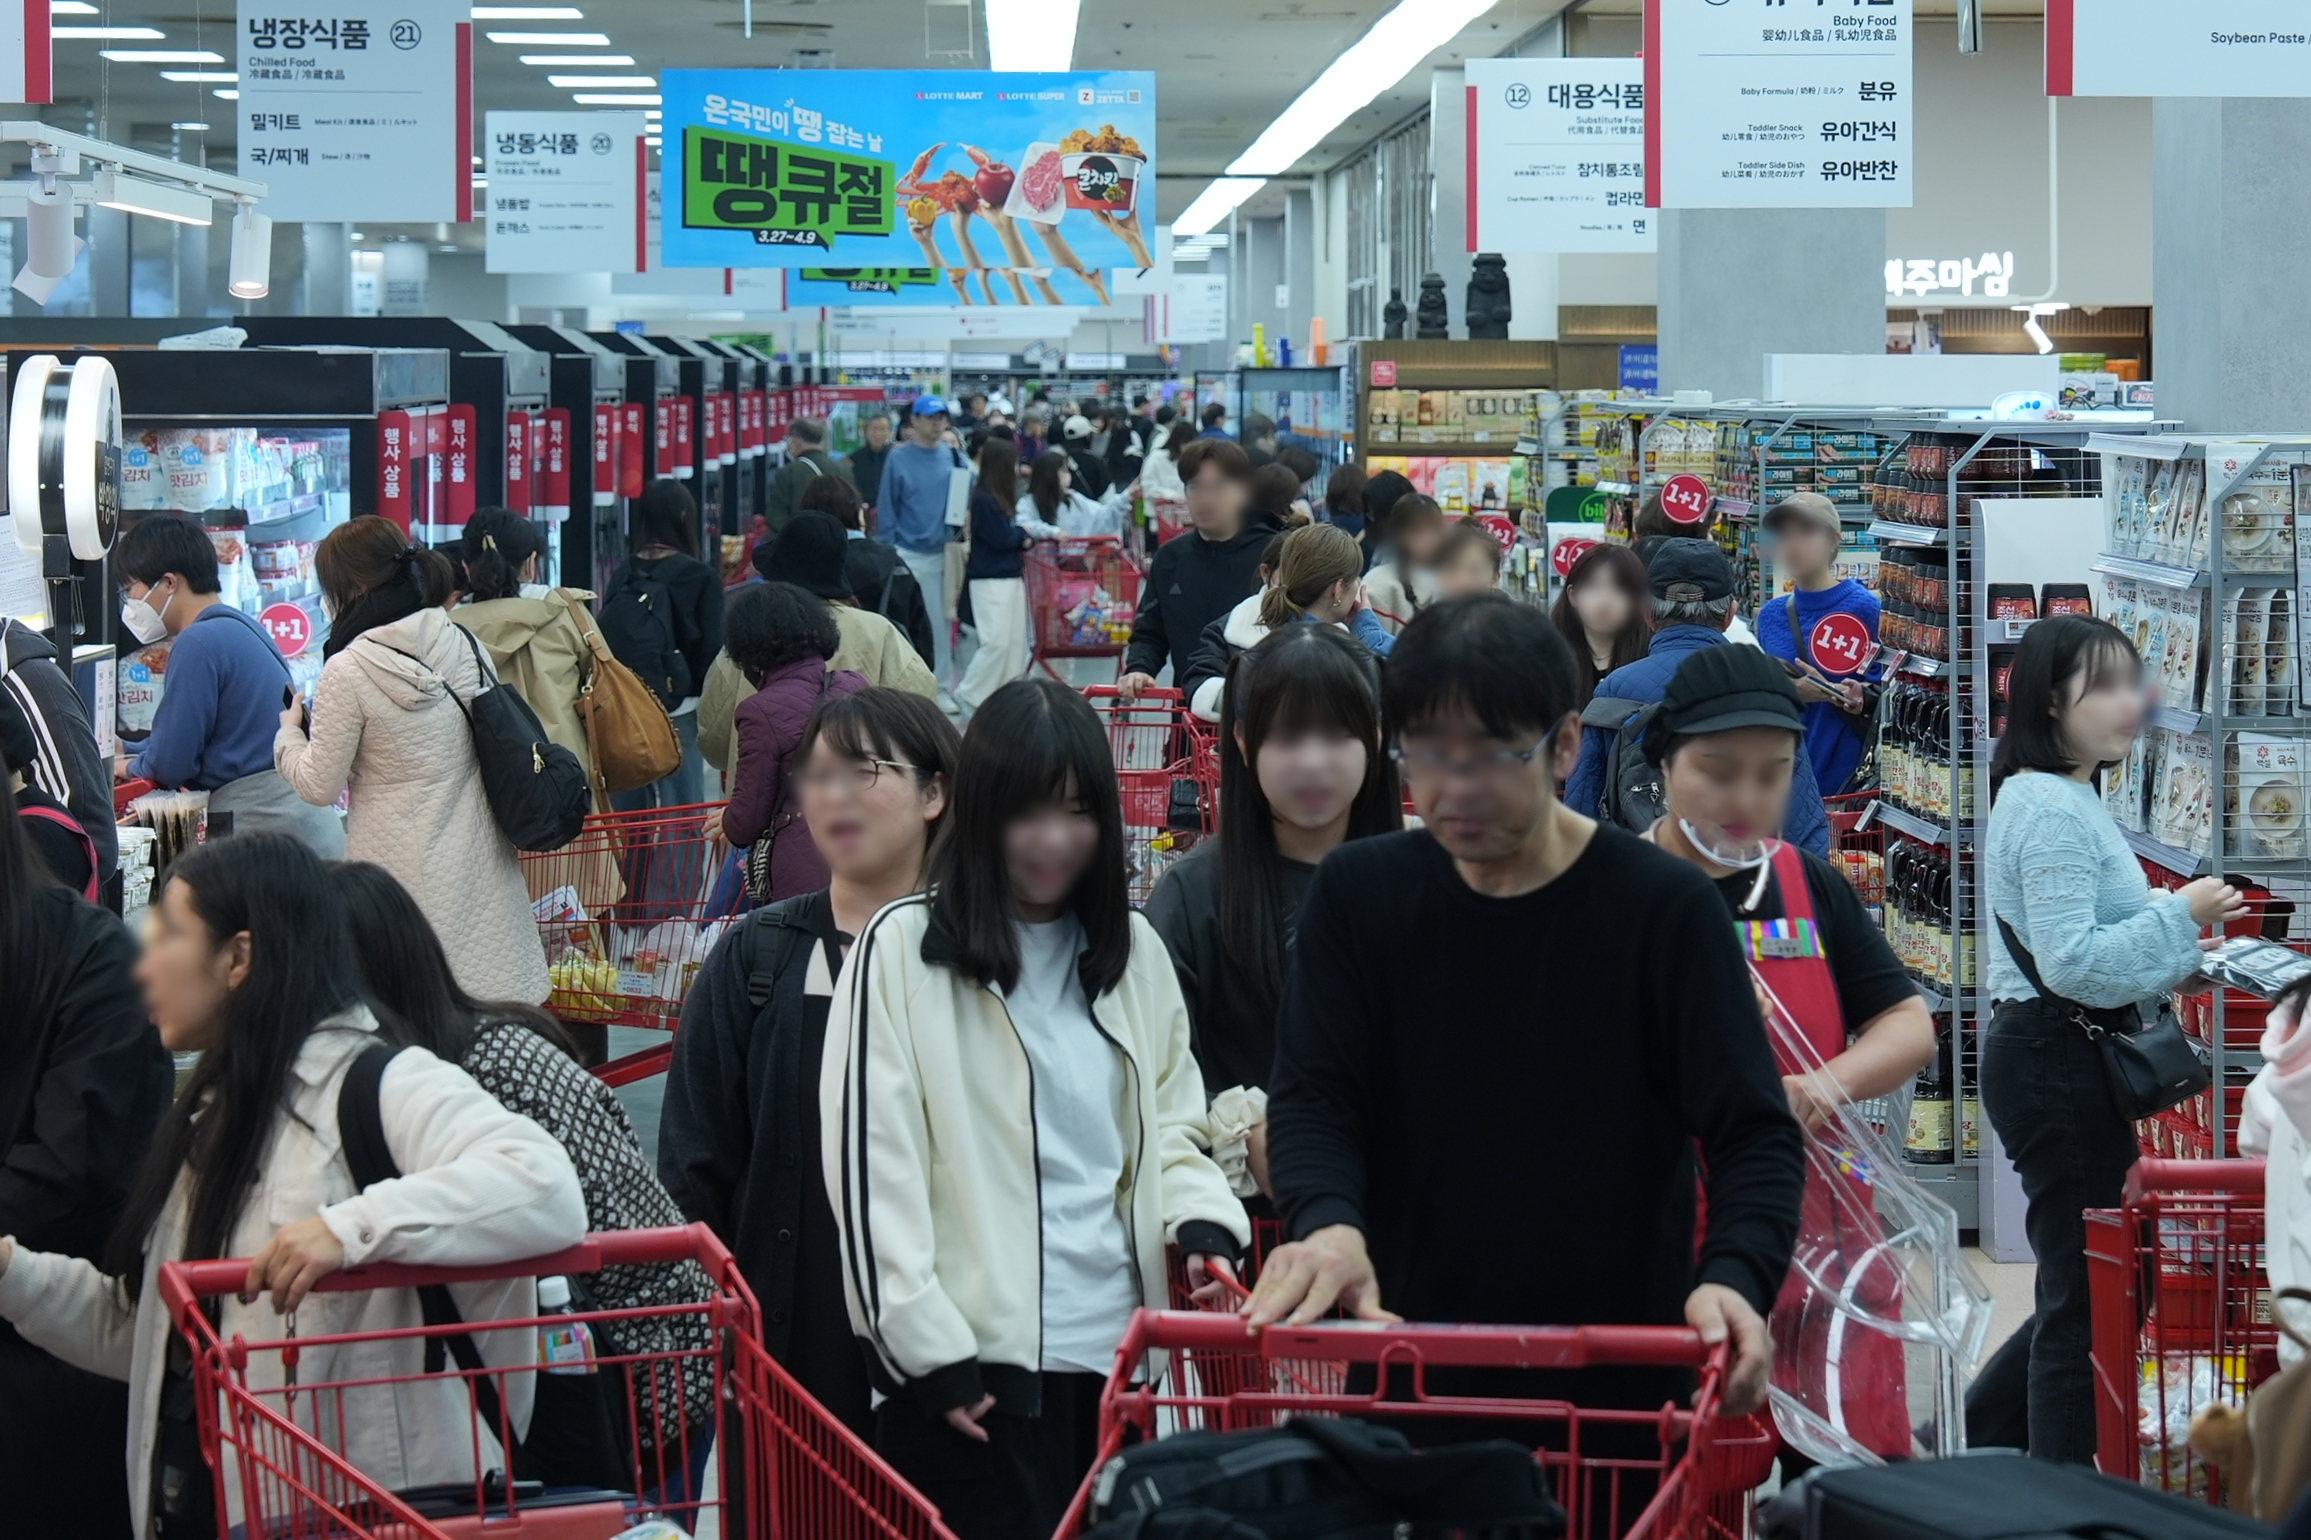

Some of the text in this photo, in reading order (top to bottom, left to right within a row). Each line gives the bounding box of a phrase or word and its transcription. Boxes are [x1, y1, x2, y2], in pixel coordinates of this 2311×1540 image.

[1833, 15, 1897, 27] Baby Food
[249, 18, 370, 50] 냉장식품
[2210, 32, 2305, 45] Soybean Paste
[249, 57, 315, 67] Chilled Food
[925, 92, 983, 100] LOTTE MART
[1037, 92, 1064, 100] SUPER
[1097, 95, 1125, 103] ZETTA
[1548, 83, 1643, 109] 대용식품
[1741, 87, 1760, 96] Baby
[1858, 81, 1897, 101] 분유
[251, 113, 301, 131] 밀키트
[703, 94, 884, 153] 온국민이 땡 잡는 날
[1576, 116, 1622, 124] Substitute
[1748, 124, 1803, 132] Toddler Snack
[1820, 121, 1896, 142] 유아간식
[496, 133, 578, 154] 냉동식품
[250, 148, 309, 165] 국/찌개
[1820, 160, 1898, 181] 유아반찬
[701, 136, 882, 225] 땡큐절
[1633, 220, 1645, 234] 면
[758, 230, 816, 244] 3.27~4.9
[450, 419, 467, 482] 행사 상품
[384, 428, 401, 498] 행사 상품
[121, 469, 150, 482] 김치
[170, 472, 207, 487] 맛김치
[1665, 484, 1702, 513] 1+1
[1486, 523, 1511, 545] 1+1
[261, 618, 303, 640] 1+1
[1816, 624, 1861, 661] 1+1
[132, 671, 147, 680] 1+1
